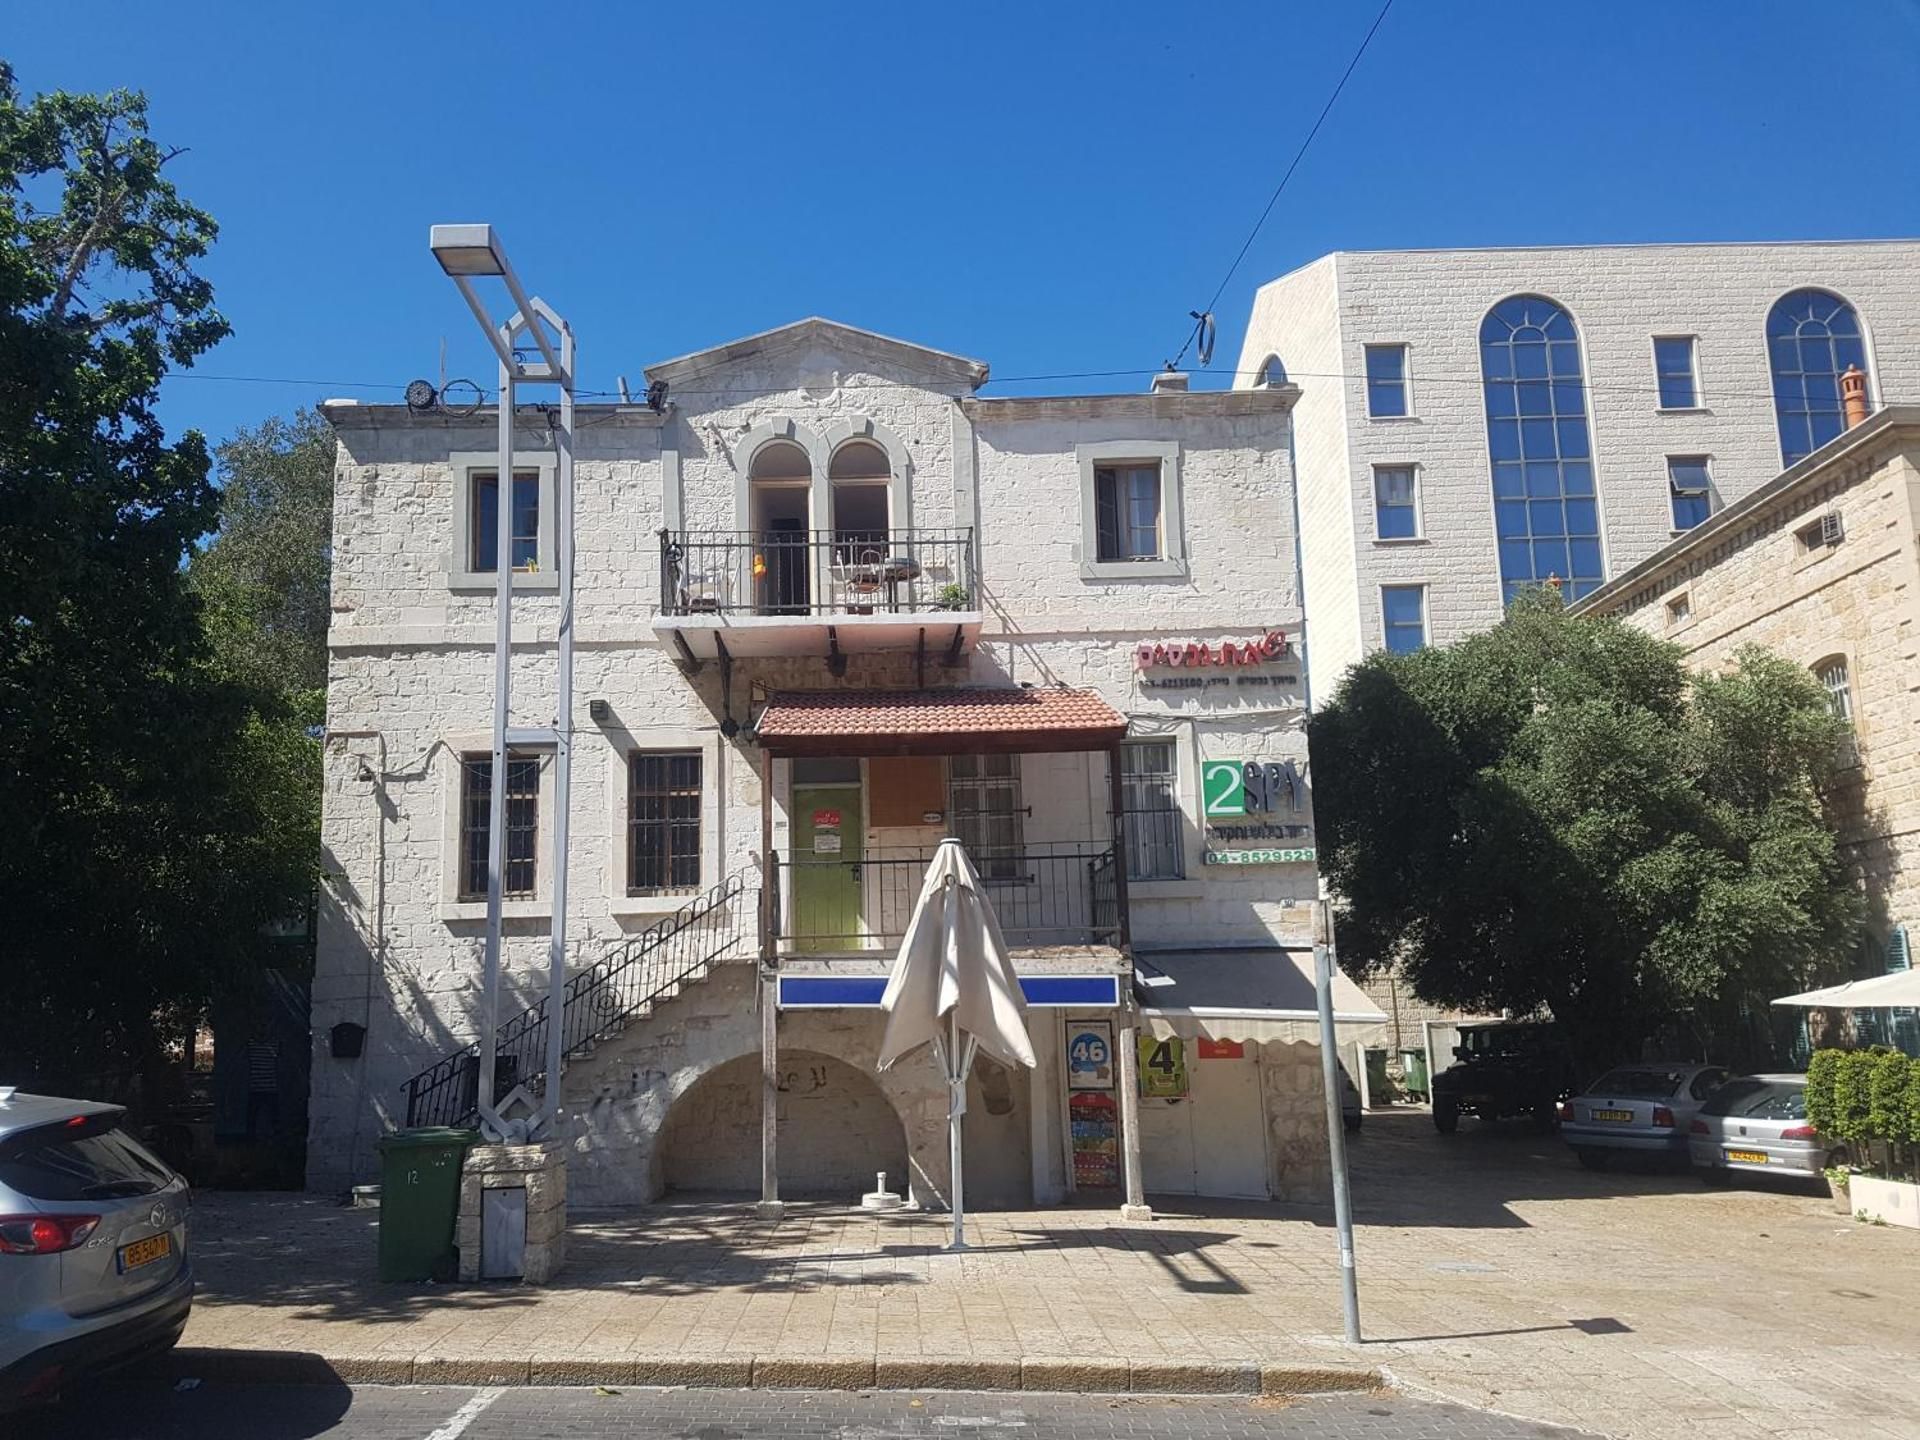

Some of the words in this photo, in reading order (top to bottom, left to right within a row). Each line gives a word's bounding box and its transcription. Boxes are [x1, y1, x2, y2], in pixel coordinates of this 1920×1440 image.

[1138, 642, 1212, 668] נכסים
[1208, 850, 1313, 864] 04-8529529
[1073, 1041, 1105, 1062] 46
[1148, 1042, 1175, 1074] 4
